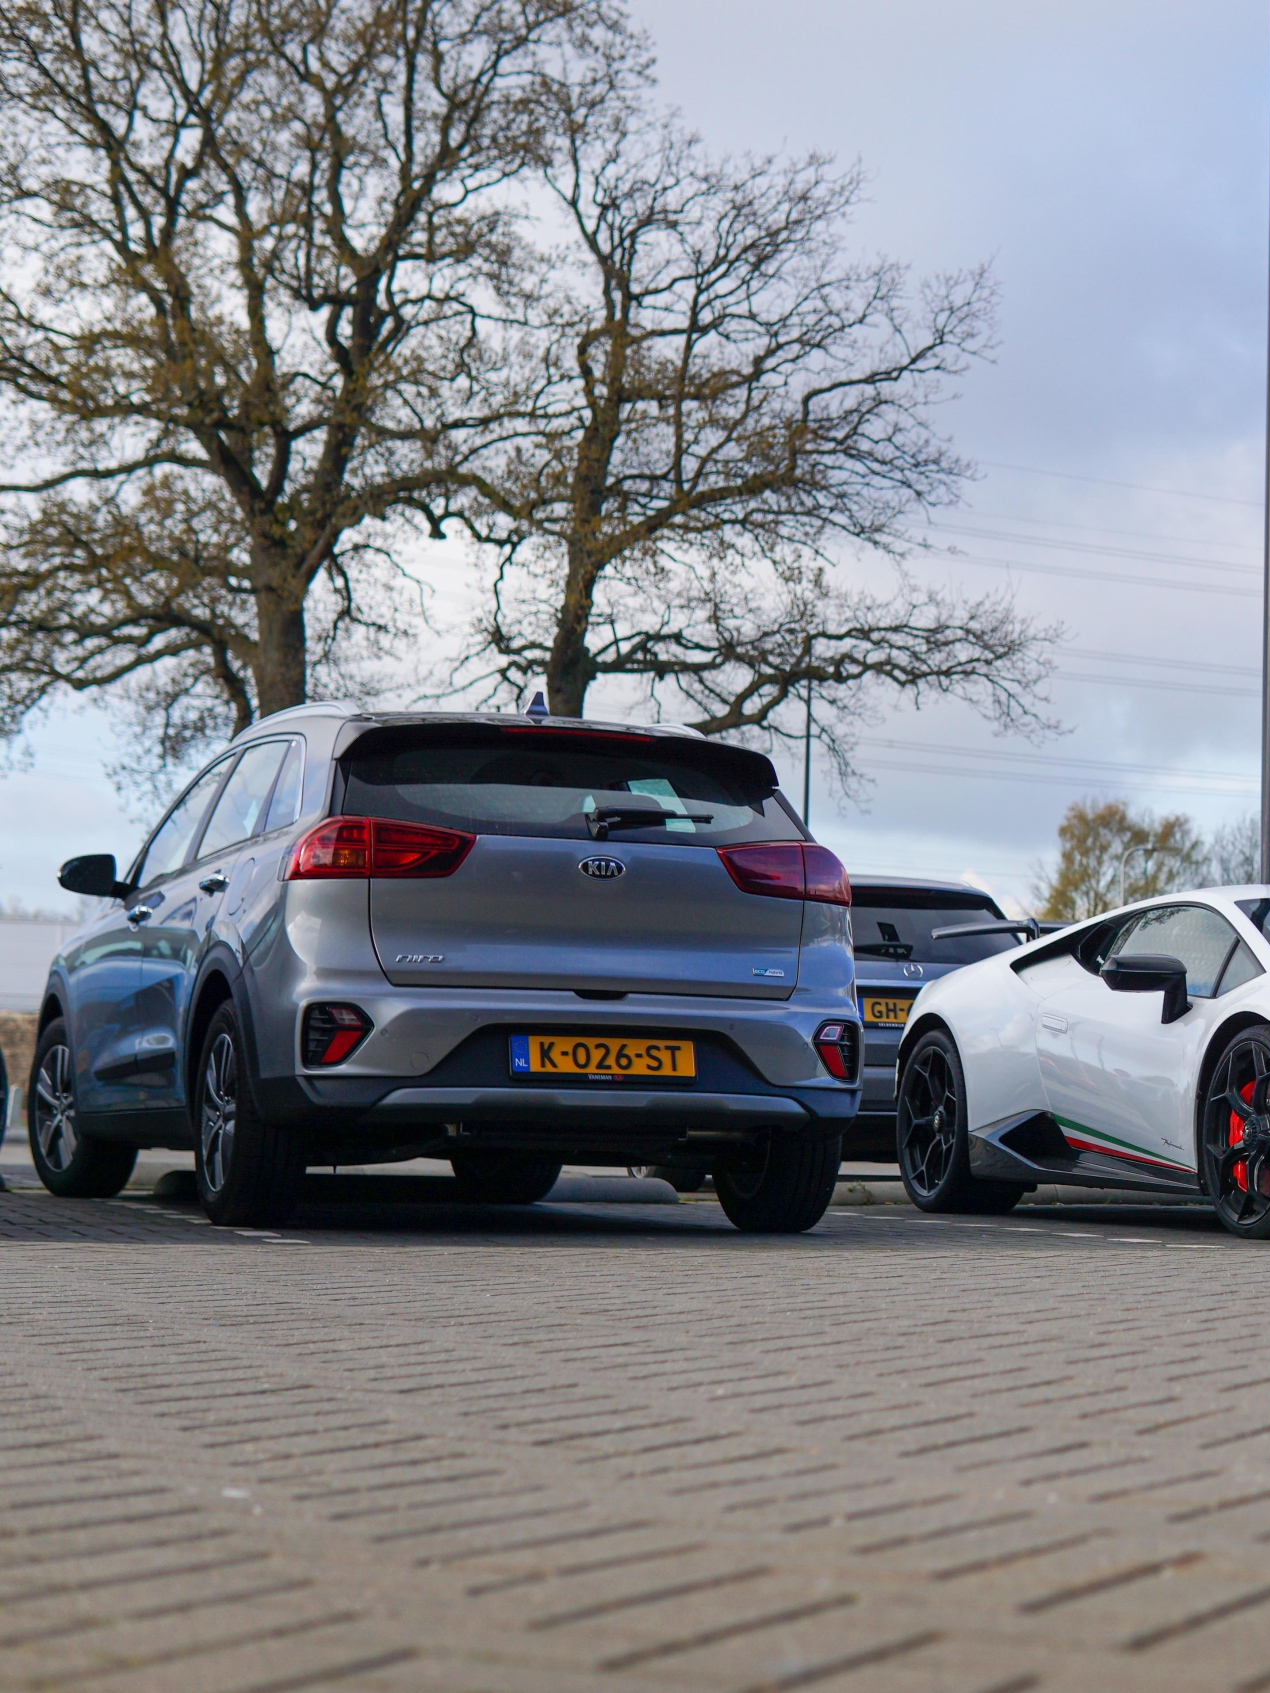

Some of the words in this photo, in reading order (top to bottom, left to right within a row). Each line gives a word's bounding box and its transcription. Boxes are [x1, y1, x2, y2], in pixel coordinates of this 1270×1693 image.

[588, 861, 618, 876] KIA
[515, 1058, 528, 1067] NL
[539, 1041, 681, 1072] K-026-ST
